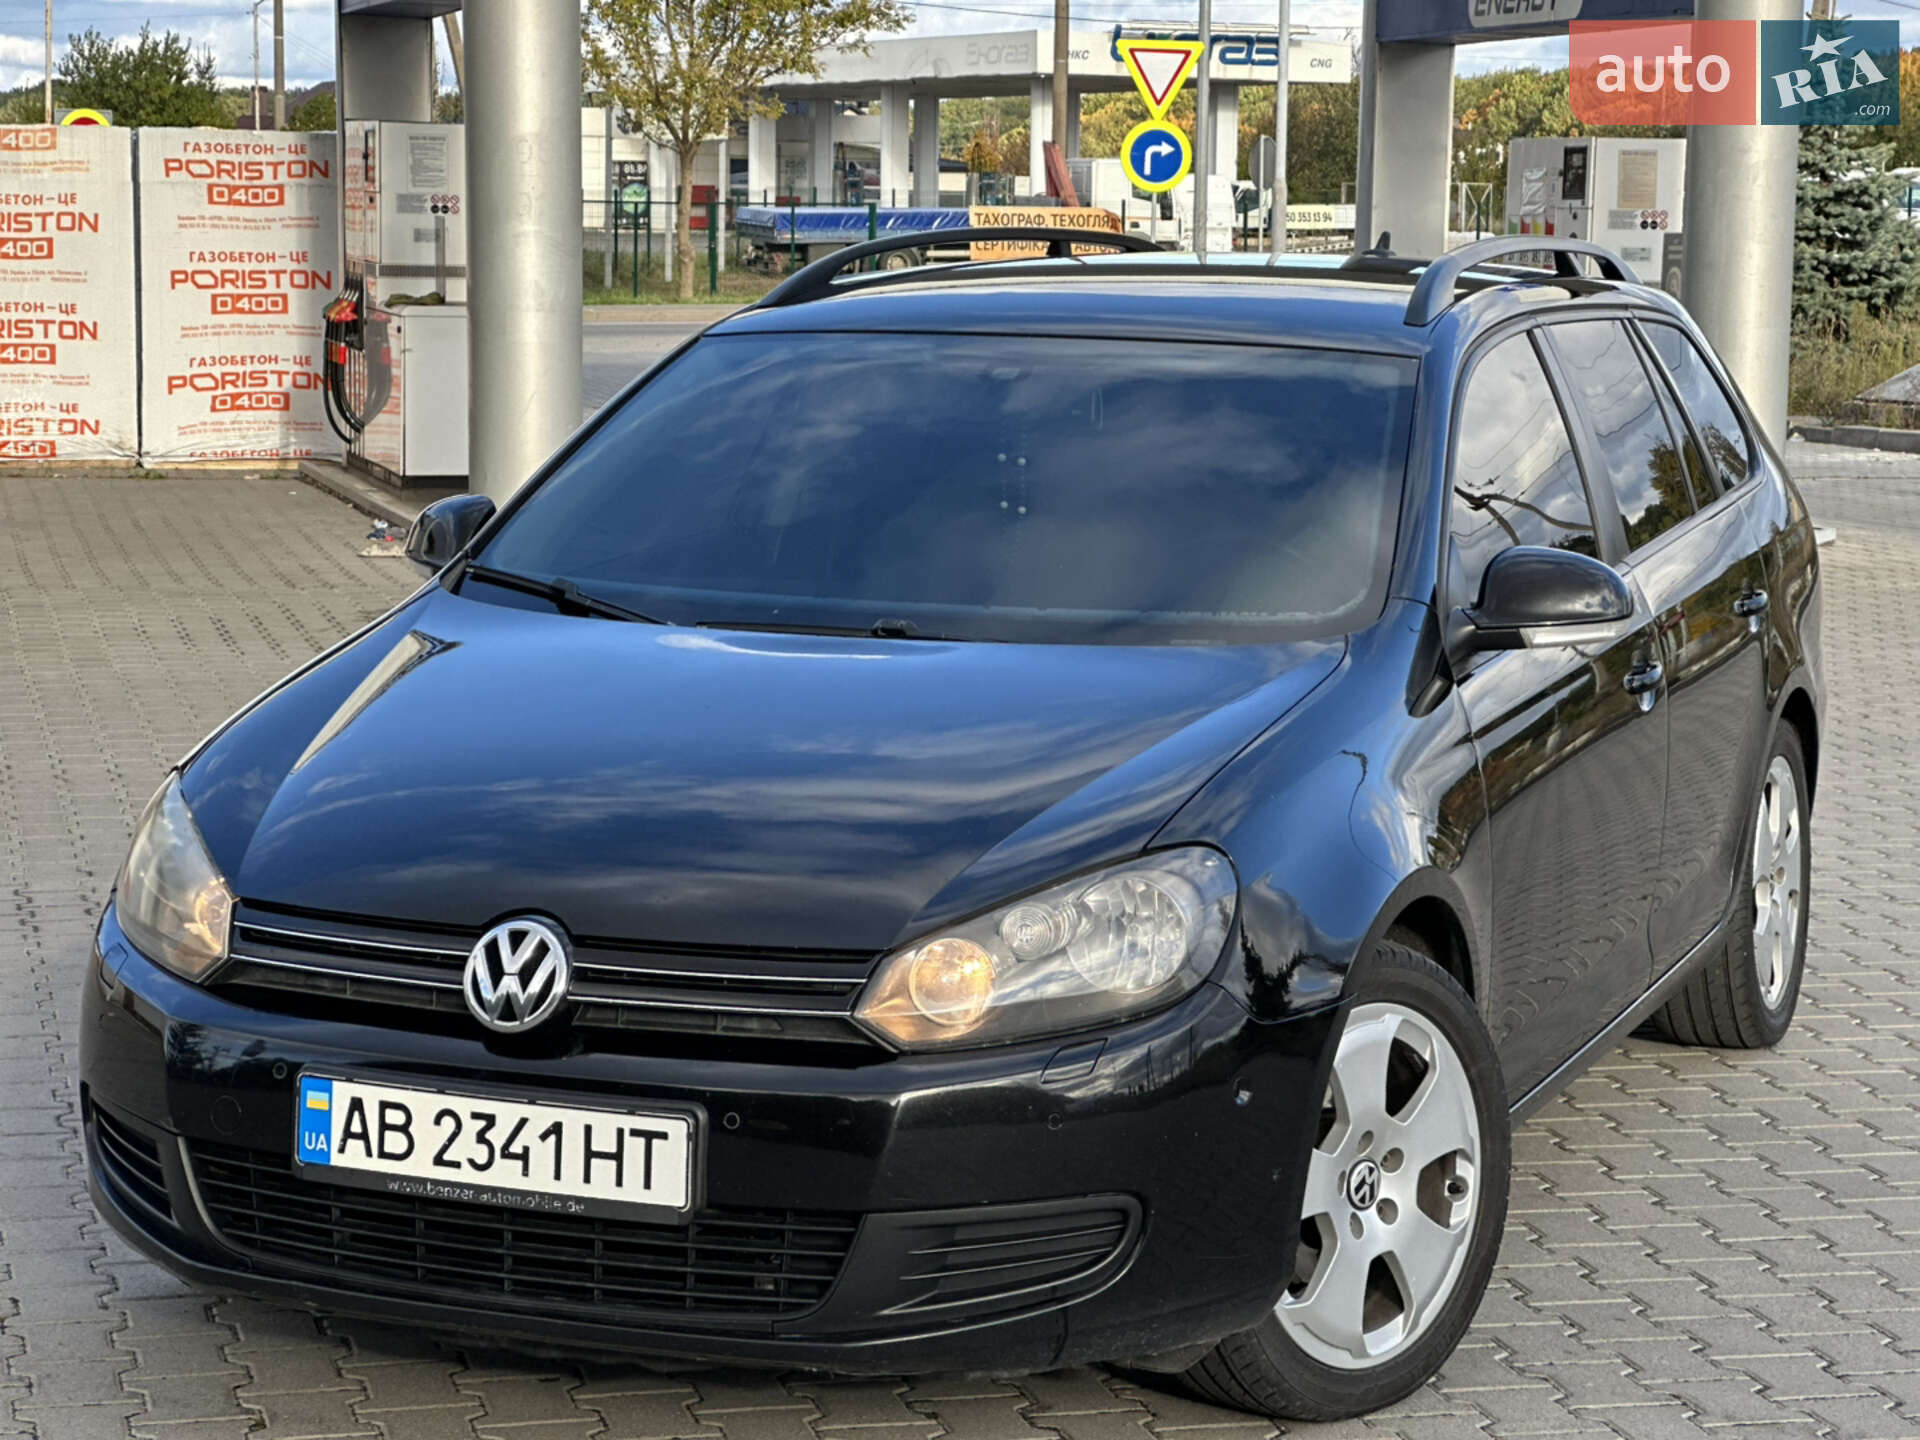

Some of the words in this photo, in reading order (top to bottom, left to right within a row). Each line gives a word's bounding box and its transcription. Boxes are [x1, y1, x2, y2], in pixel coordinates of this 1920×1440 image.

[1310, 58, 1333, 69] CNG
[163, 158, 329, 181] PORISTON
[170, 268, 332, 290] PORISTON
[0, 318, 98, 340] ISTON
[0, 416, 100, 436] ISTON
[304, 1131, 329, 1152] UA
[337, 1096, 415, 1162] AB
[432, 1107, 564, 1182] 2341
[583, 1123, 669, 1191] HT
